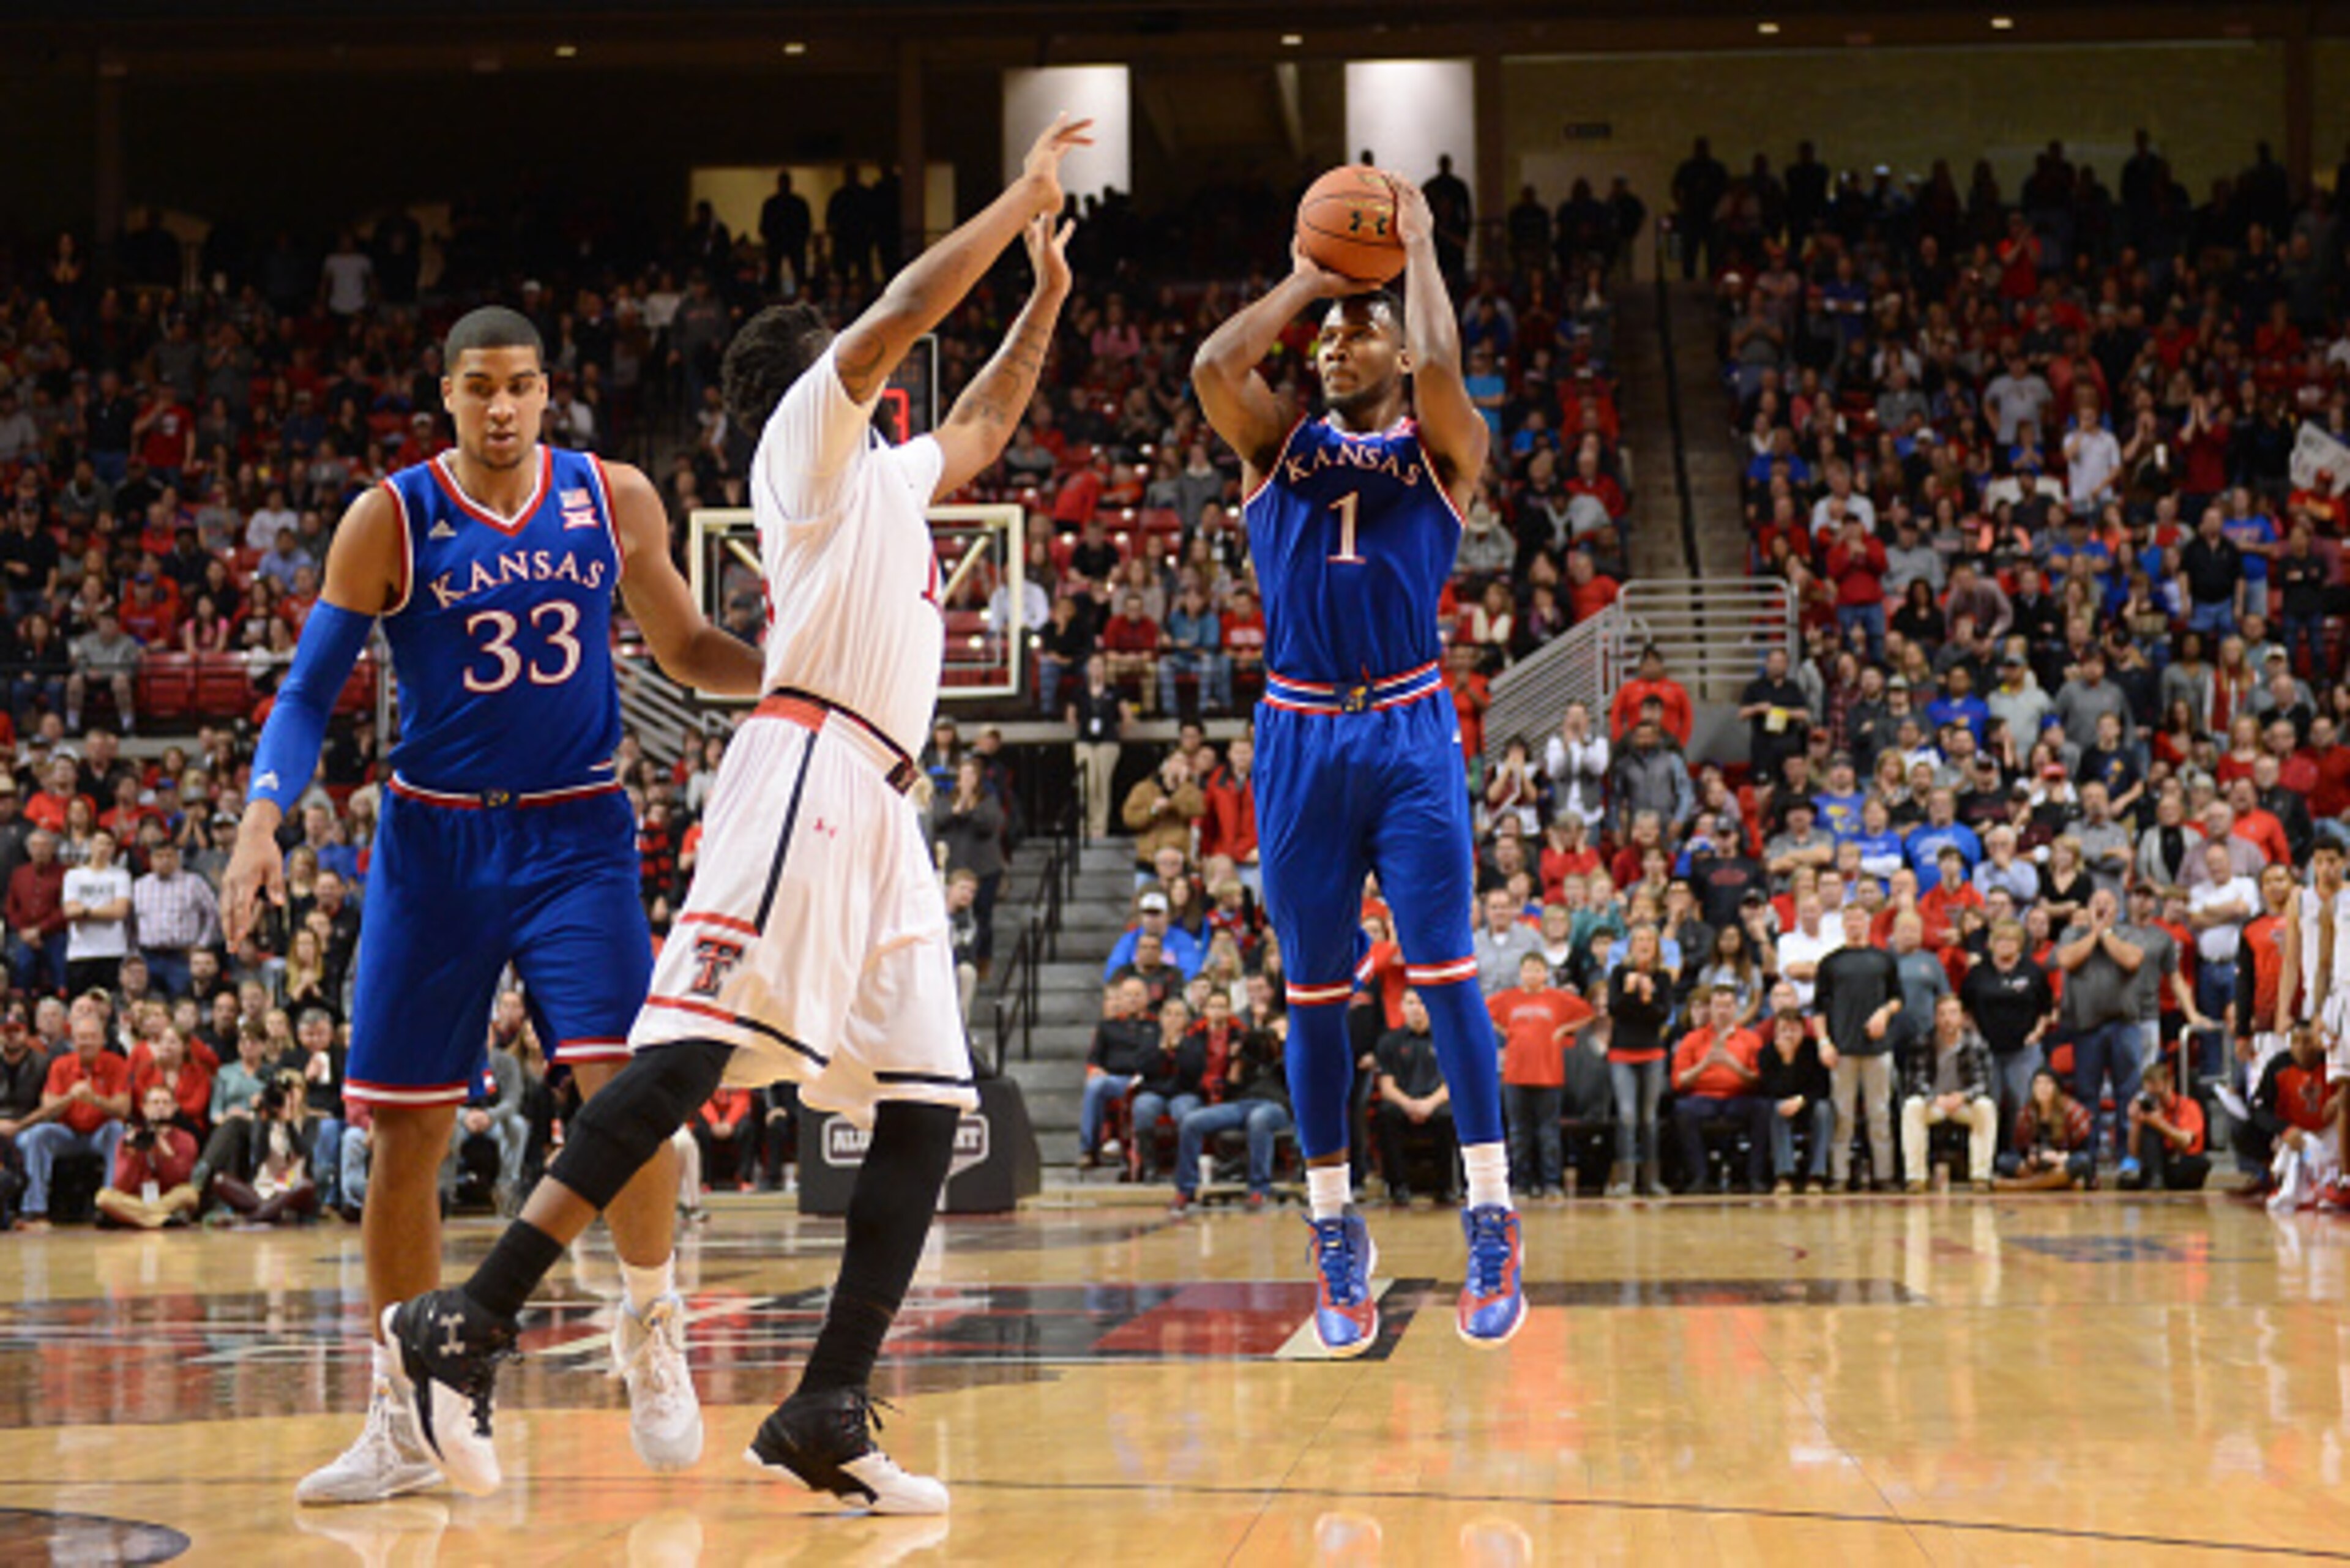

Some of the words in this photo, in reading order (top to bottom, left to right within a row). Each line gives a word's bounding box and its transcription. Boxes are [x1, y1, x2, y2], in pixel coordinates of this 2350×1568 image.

[1286, 441, 1422, 487] KANSAS
[1327, 490, 1367, 564] 1
[427, 550, 605, 610] KANSAS
[463, 599, 581, 694] 33
